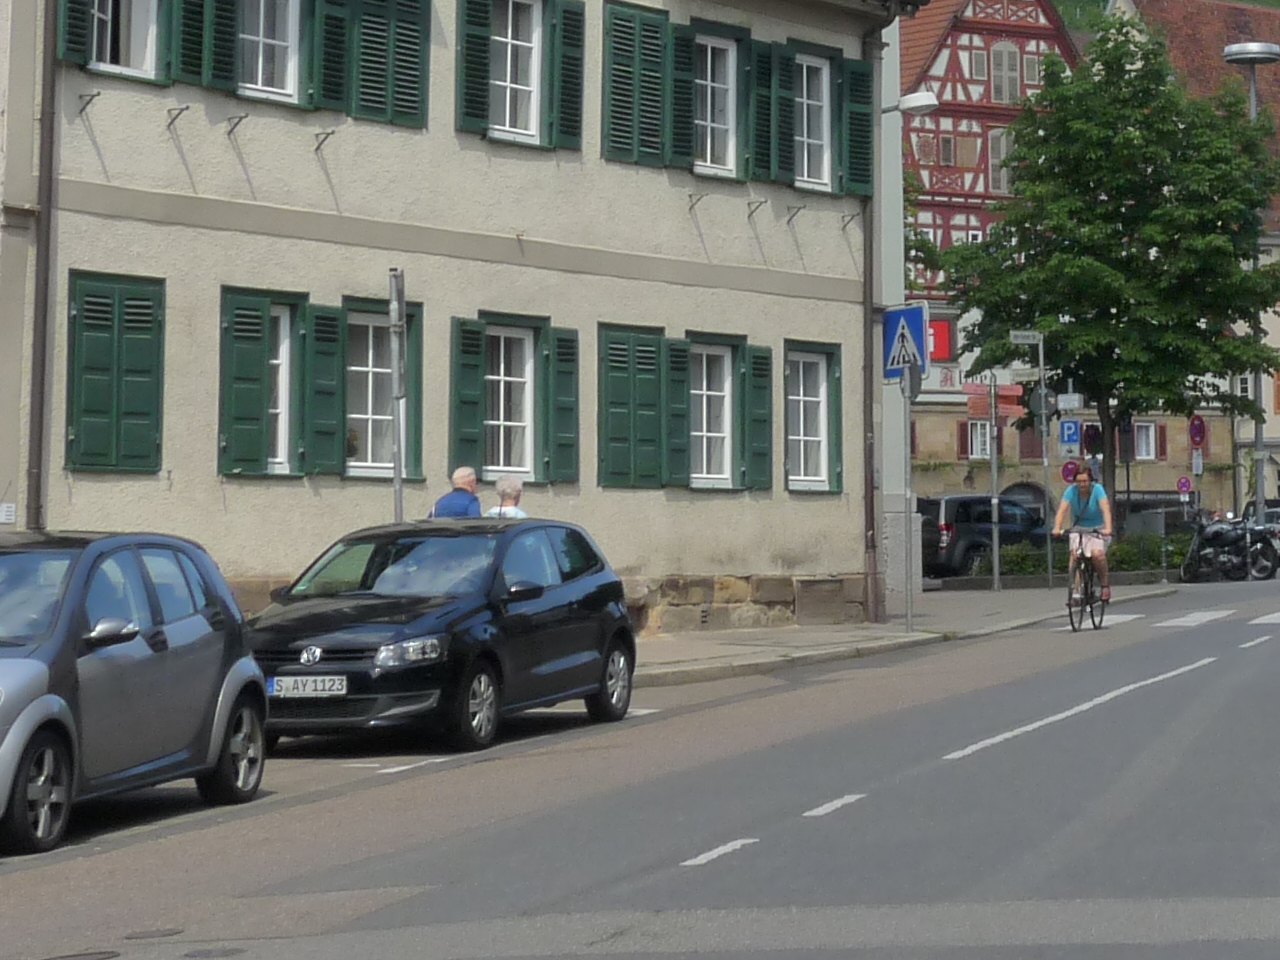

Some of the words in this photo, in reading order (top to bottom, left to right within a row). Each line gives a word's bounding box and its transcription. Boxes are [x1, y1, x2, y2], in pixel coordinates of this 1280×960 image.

[1063, 422, 1075, 442] P
[275, 679, 284, 693] S
[292, 679, 309, 693] AY
[311, 678, 345, 693] 1123
